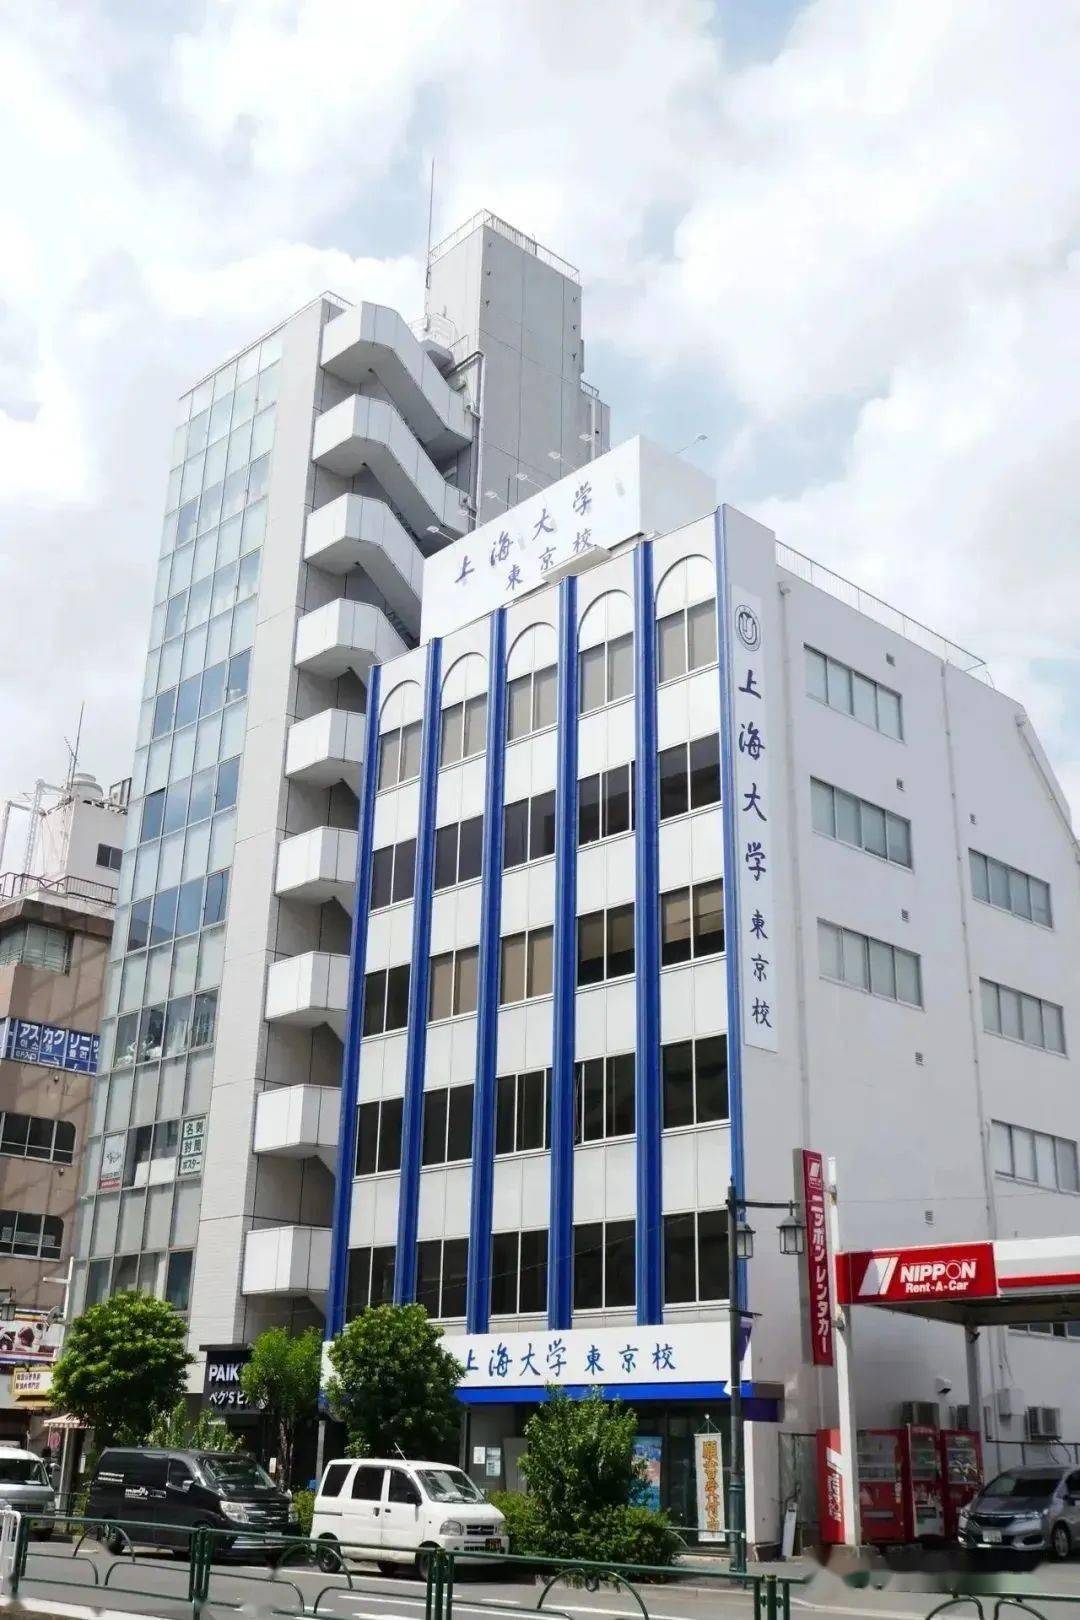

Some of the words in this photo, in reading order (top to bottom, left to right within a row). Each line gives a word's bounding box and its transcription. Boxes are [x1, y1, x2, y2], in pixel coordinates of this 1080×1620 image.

[455, 481, 593, 583] 上海大学
[505, 528, 593, 591] 東京校
[738, 669, 773, 1029] 上海大学東京校
[811, 1194, 829, 1354] ニッポンレンタカー
[900, 1260, 977, 1283] NIPPON
[465, 1337, 677, 1378] 上海大学東京校
